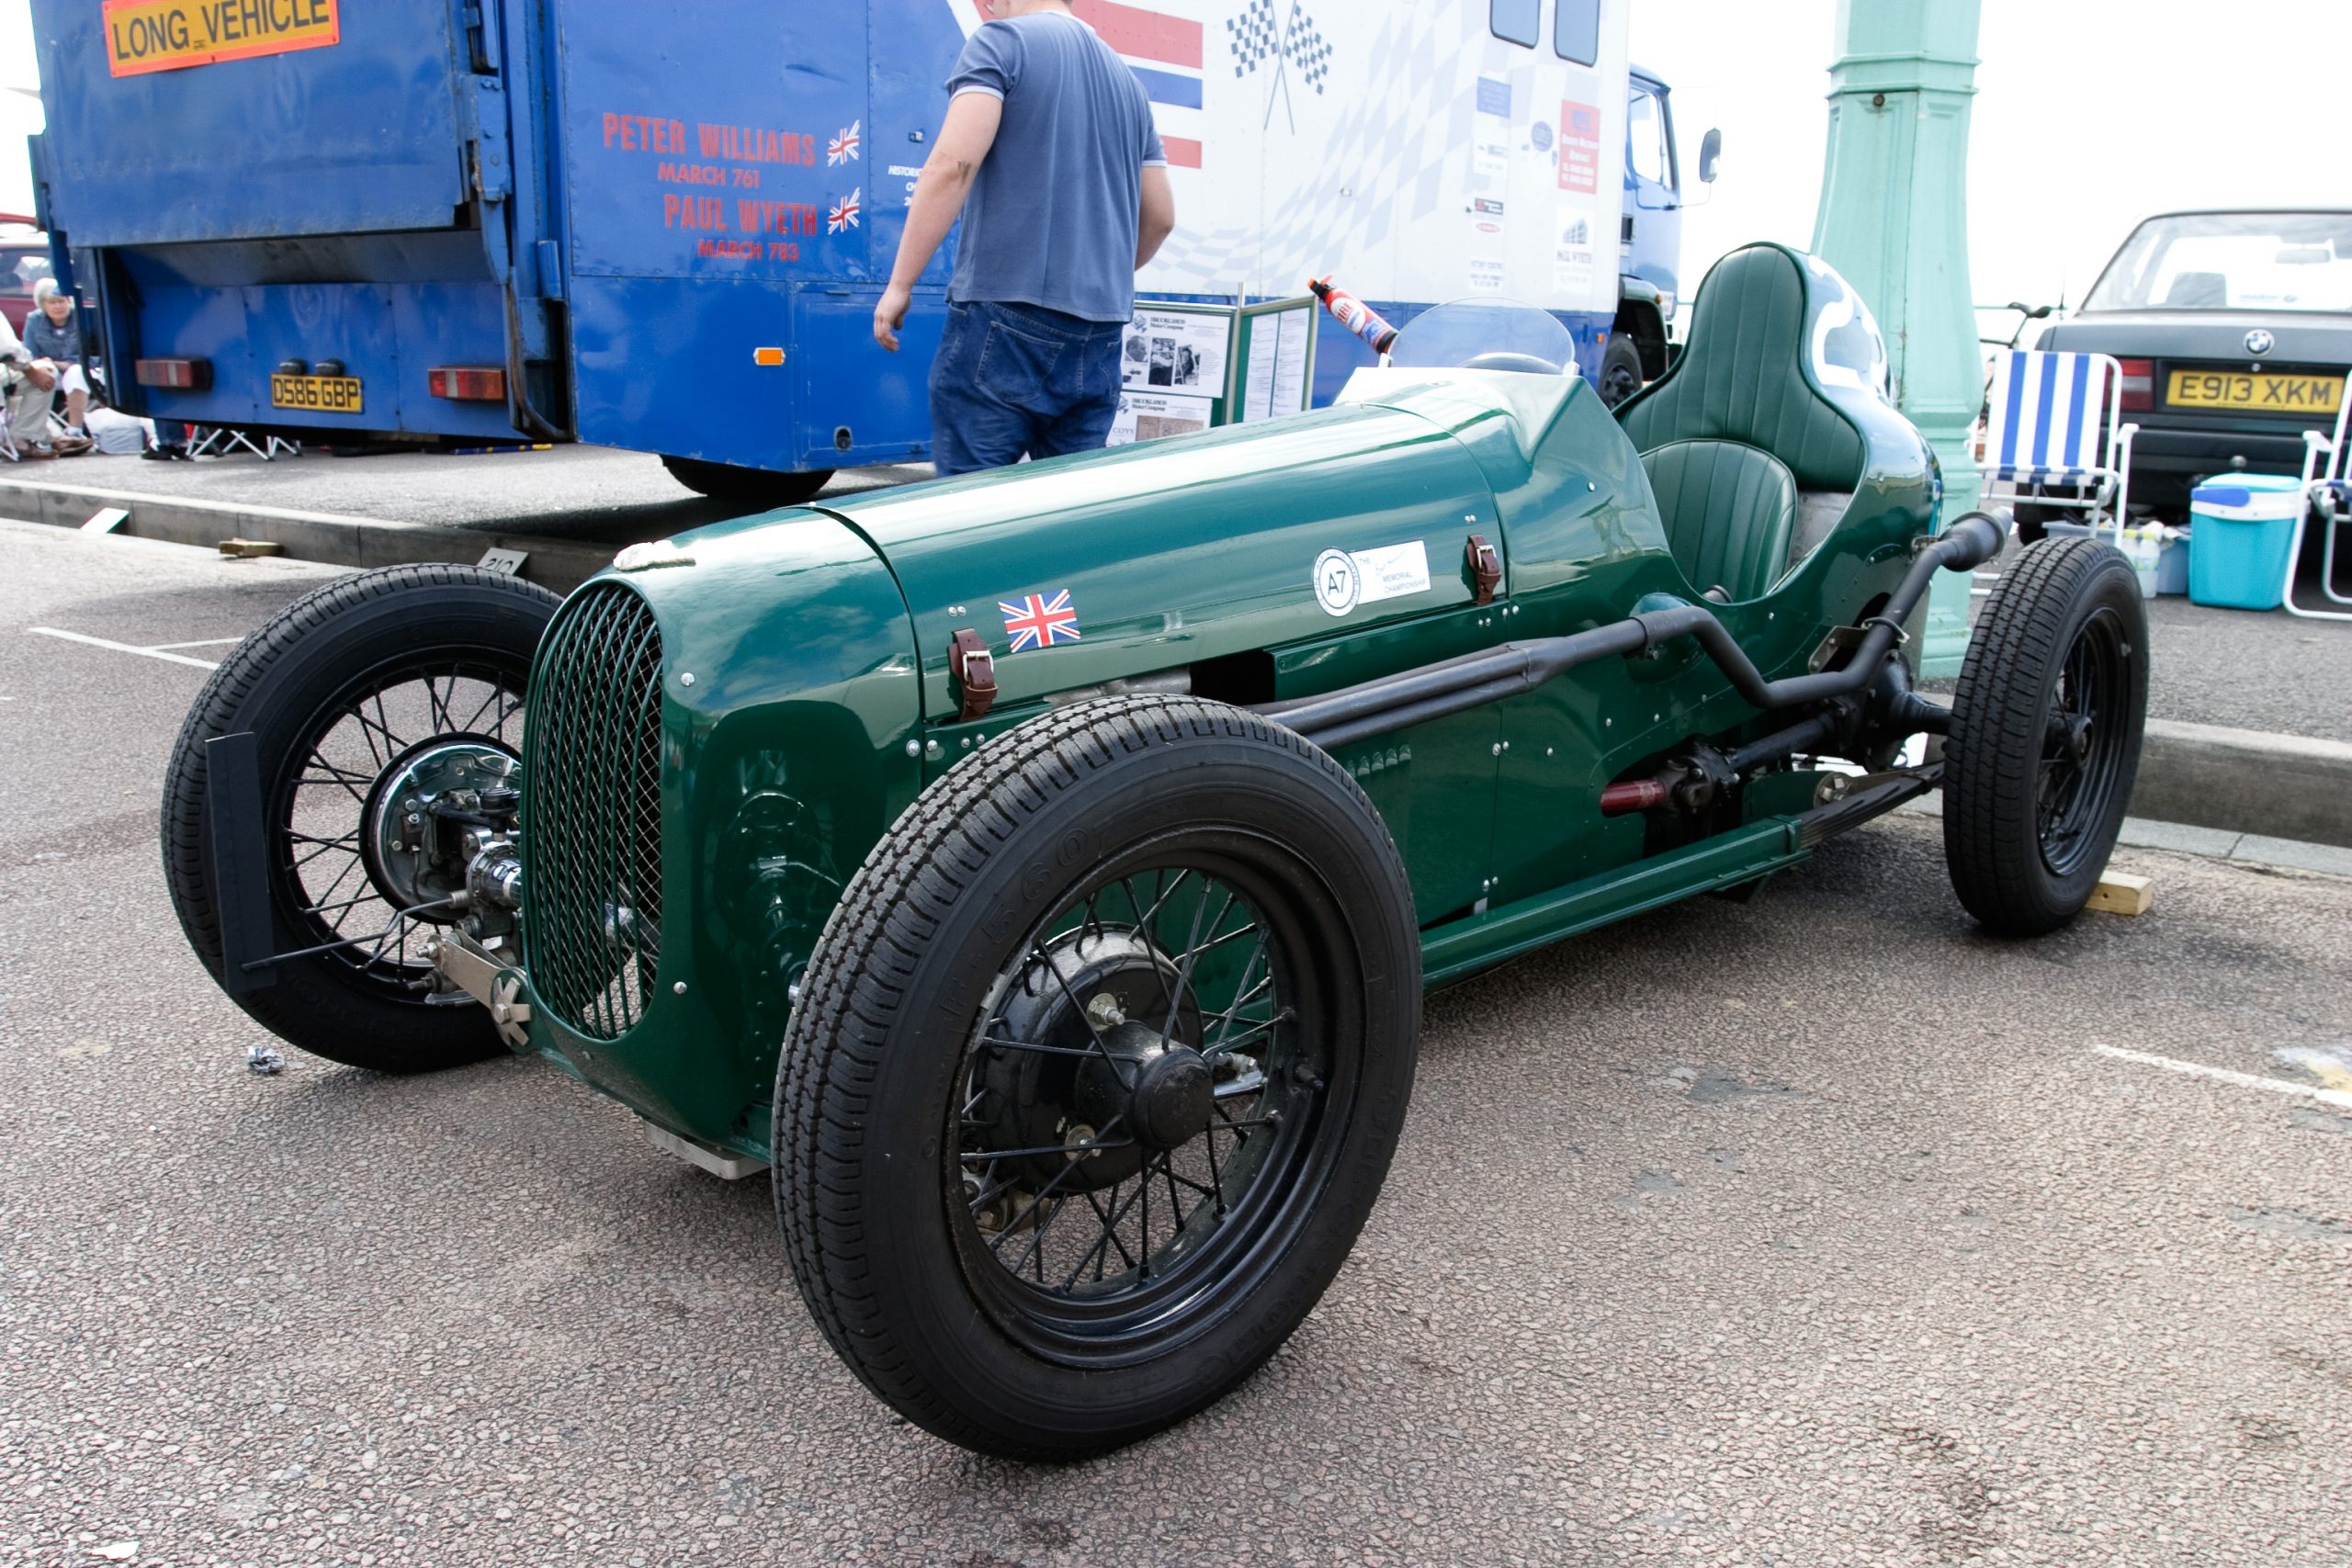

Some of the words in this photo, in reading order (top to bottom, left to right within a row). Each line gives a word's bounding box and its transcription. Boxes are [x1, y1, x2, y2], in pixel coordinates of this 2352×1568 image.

[113, 9, 189, 61] LONG
[201, 0, 330, 43] VEHICLE
[603, 112, 686, 154] PETER
[697, 122, 816, 167] WILLIAMS
[657, 162, 726, 186] MARCH
[732, 168, 760, 188] 761
[664, 194, 728, 231] PAUL
[738, 198, 817, 235] WYETH
[697, 238, 763, 260] MARCH
[273, 378, 318, 405] D586
[321, 379, 359, 408] GBP
[2178, 375, 2254, 401] E913
[2263, 378, 2332, 405] XKM
[1328, 570, 1346, 595] A7
